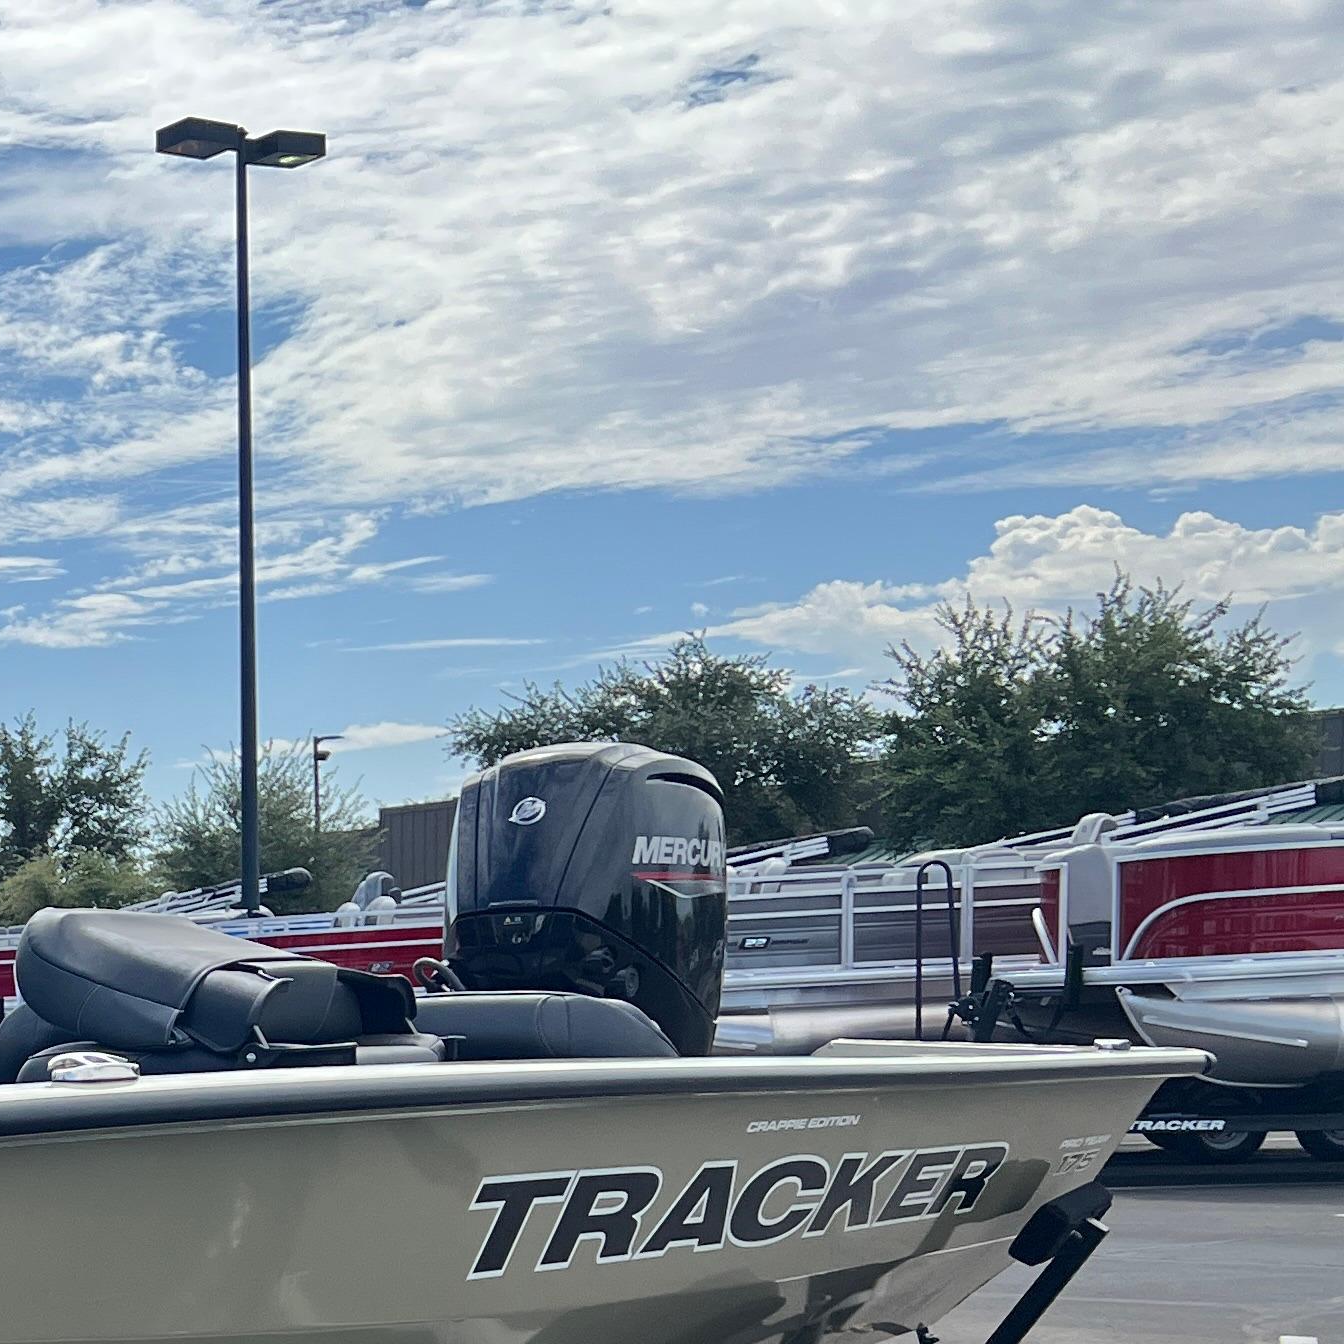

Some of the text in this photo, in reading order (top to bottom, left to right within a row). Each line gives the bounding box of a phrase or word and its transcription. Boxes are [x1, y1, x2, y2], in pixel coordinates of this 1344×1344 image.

[747, 1115, 861, 1133] CRAPPIE EDITION
[465, 1141, 1010, 1281] TRACKER
